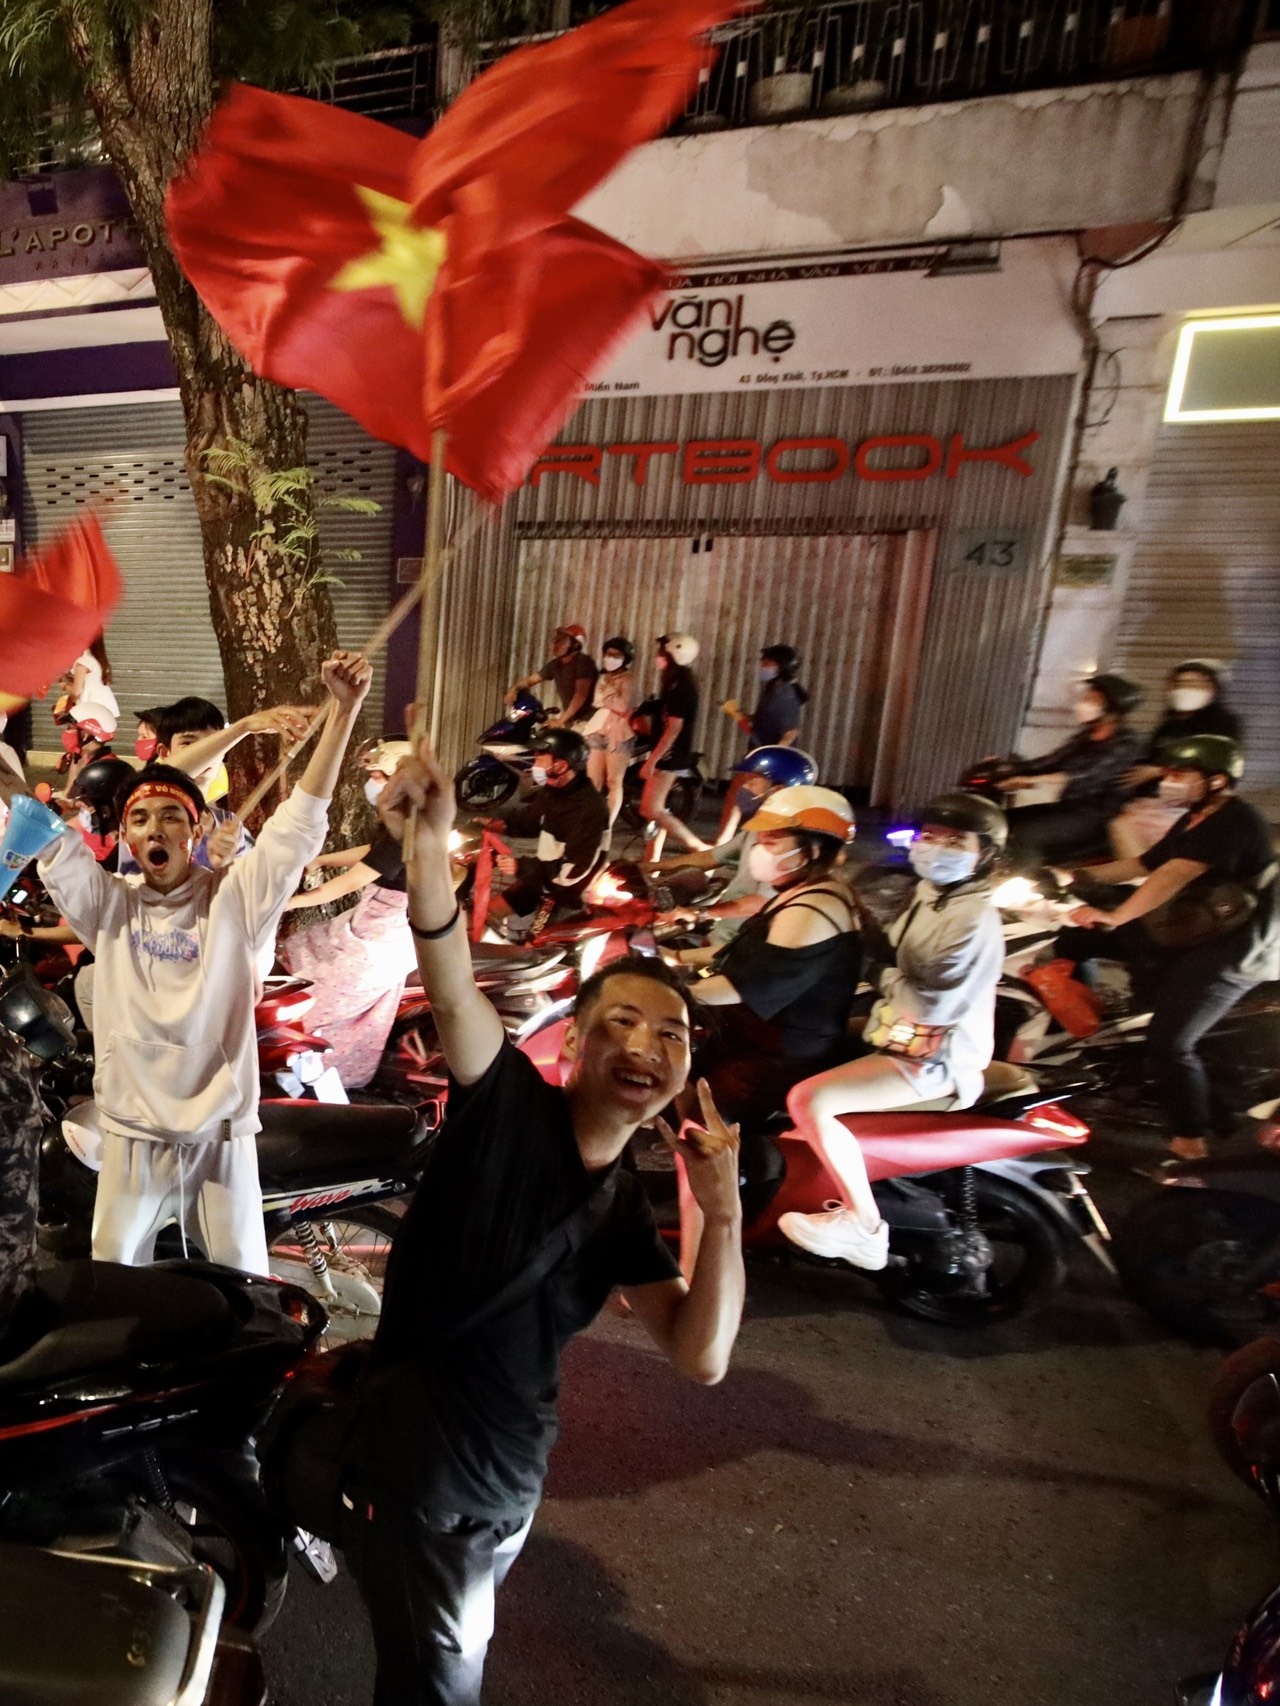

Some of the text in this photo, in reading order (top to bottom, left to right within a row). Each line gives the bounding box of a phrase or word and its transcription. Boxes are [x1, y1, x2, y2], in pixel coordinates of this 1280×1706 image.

[649, 294, 732, 331] văn
[668, 294, 796, 368] nghệ
[520, 429, 1041, 486] RTBOOK
[963, 540, 1018, 569] 43
[290, 1189, 352, 1215] Wave
